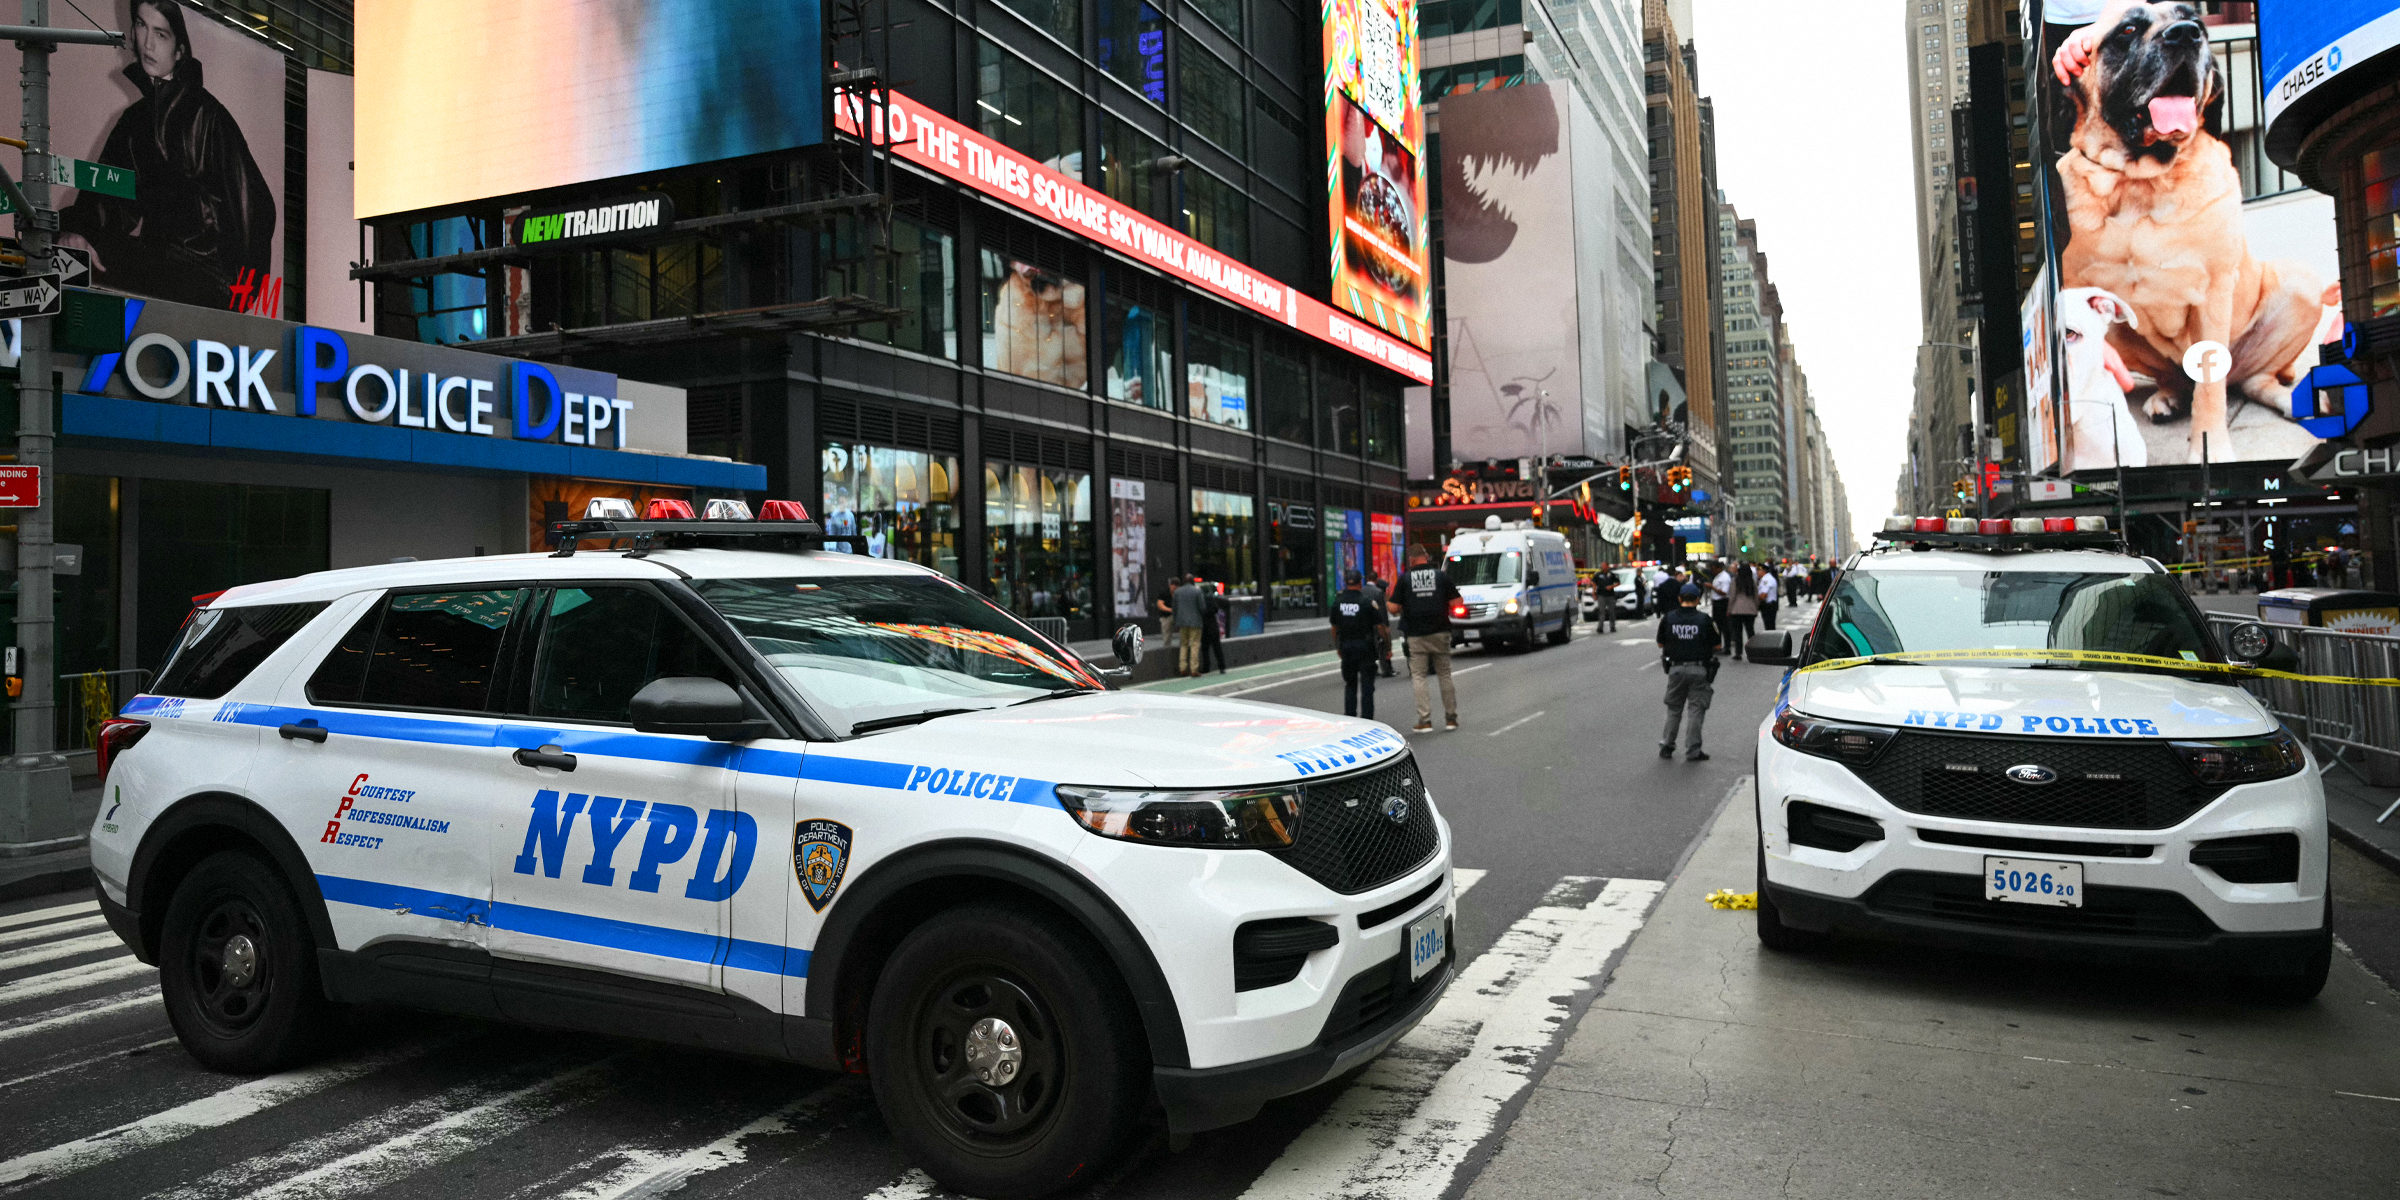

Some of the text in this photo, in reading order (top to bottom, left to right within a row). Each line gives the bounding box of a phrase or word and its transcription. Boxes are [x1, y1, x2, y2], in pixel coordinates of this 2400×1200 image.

[2283, 56, 2325, 101] CHASE
[90, 166, 120, 187] 7 Av
[912, 113, 960, 168] THE
[963, 138, 1030, 200] TIMES
[1032, 172, 1108, 236] SQUARE
[1109, 208, 1185, 271] SKYWALK
[1185, 246, 1252, 300] AVAILABLE
[1252, 278, 1282, 313] NOW
[1960, 113, 1977, 287] TIMES SQUARE
[522, 199, 660, 244] NEWTRADITION
[52, 257, 73, 274] AY
[23, 286, 50, 304] WAY
[229, 265, 283, 320] H&M
[296, 325, 494, 435] POLICE
[512, 361, 634, 449] DEPT
[2335, 447, 2400, 476] CH
[1442, 477, 1545, 501] Subwa
[1411, 569, 1435, 581] NYPD
[1412, 579, 1436, 588] POLICE
[1340, 603, 1360, 612] NYPD
[1672, 624, 1699, 635] NYPD
[1904, 709, 2160, 736] NYPD POLICE
[1276, 744, 1356, 776] NYPD
[2017, 768, 2047, 780] Ford
[348, 773, 416, 802] COURTESY
[907, 765, 1015, 801] POLICE
[334, 796, 450, 833] PROFESSIONALISM
[810, 822, 838, 835] POLICE
[320, 820, 383, 849] RESPECT
[513, 789, 758, 902] NYPD
[797, 831, 848, 850] DEPARTMENT
[795, 854, 811, 891] CITY OF
[825, 856, 847, 899] NEW YORK
[1994, 869, 2075, 896] 5026 20
[1414, 928, 1443, 967] 4520 25
